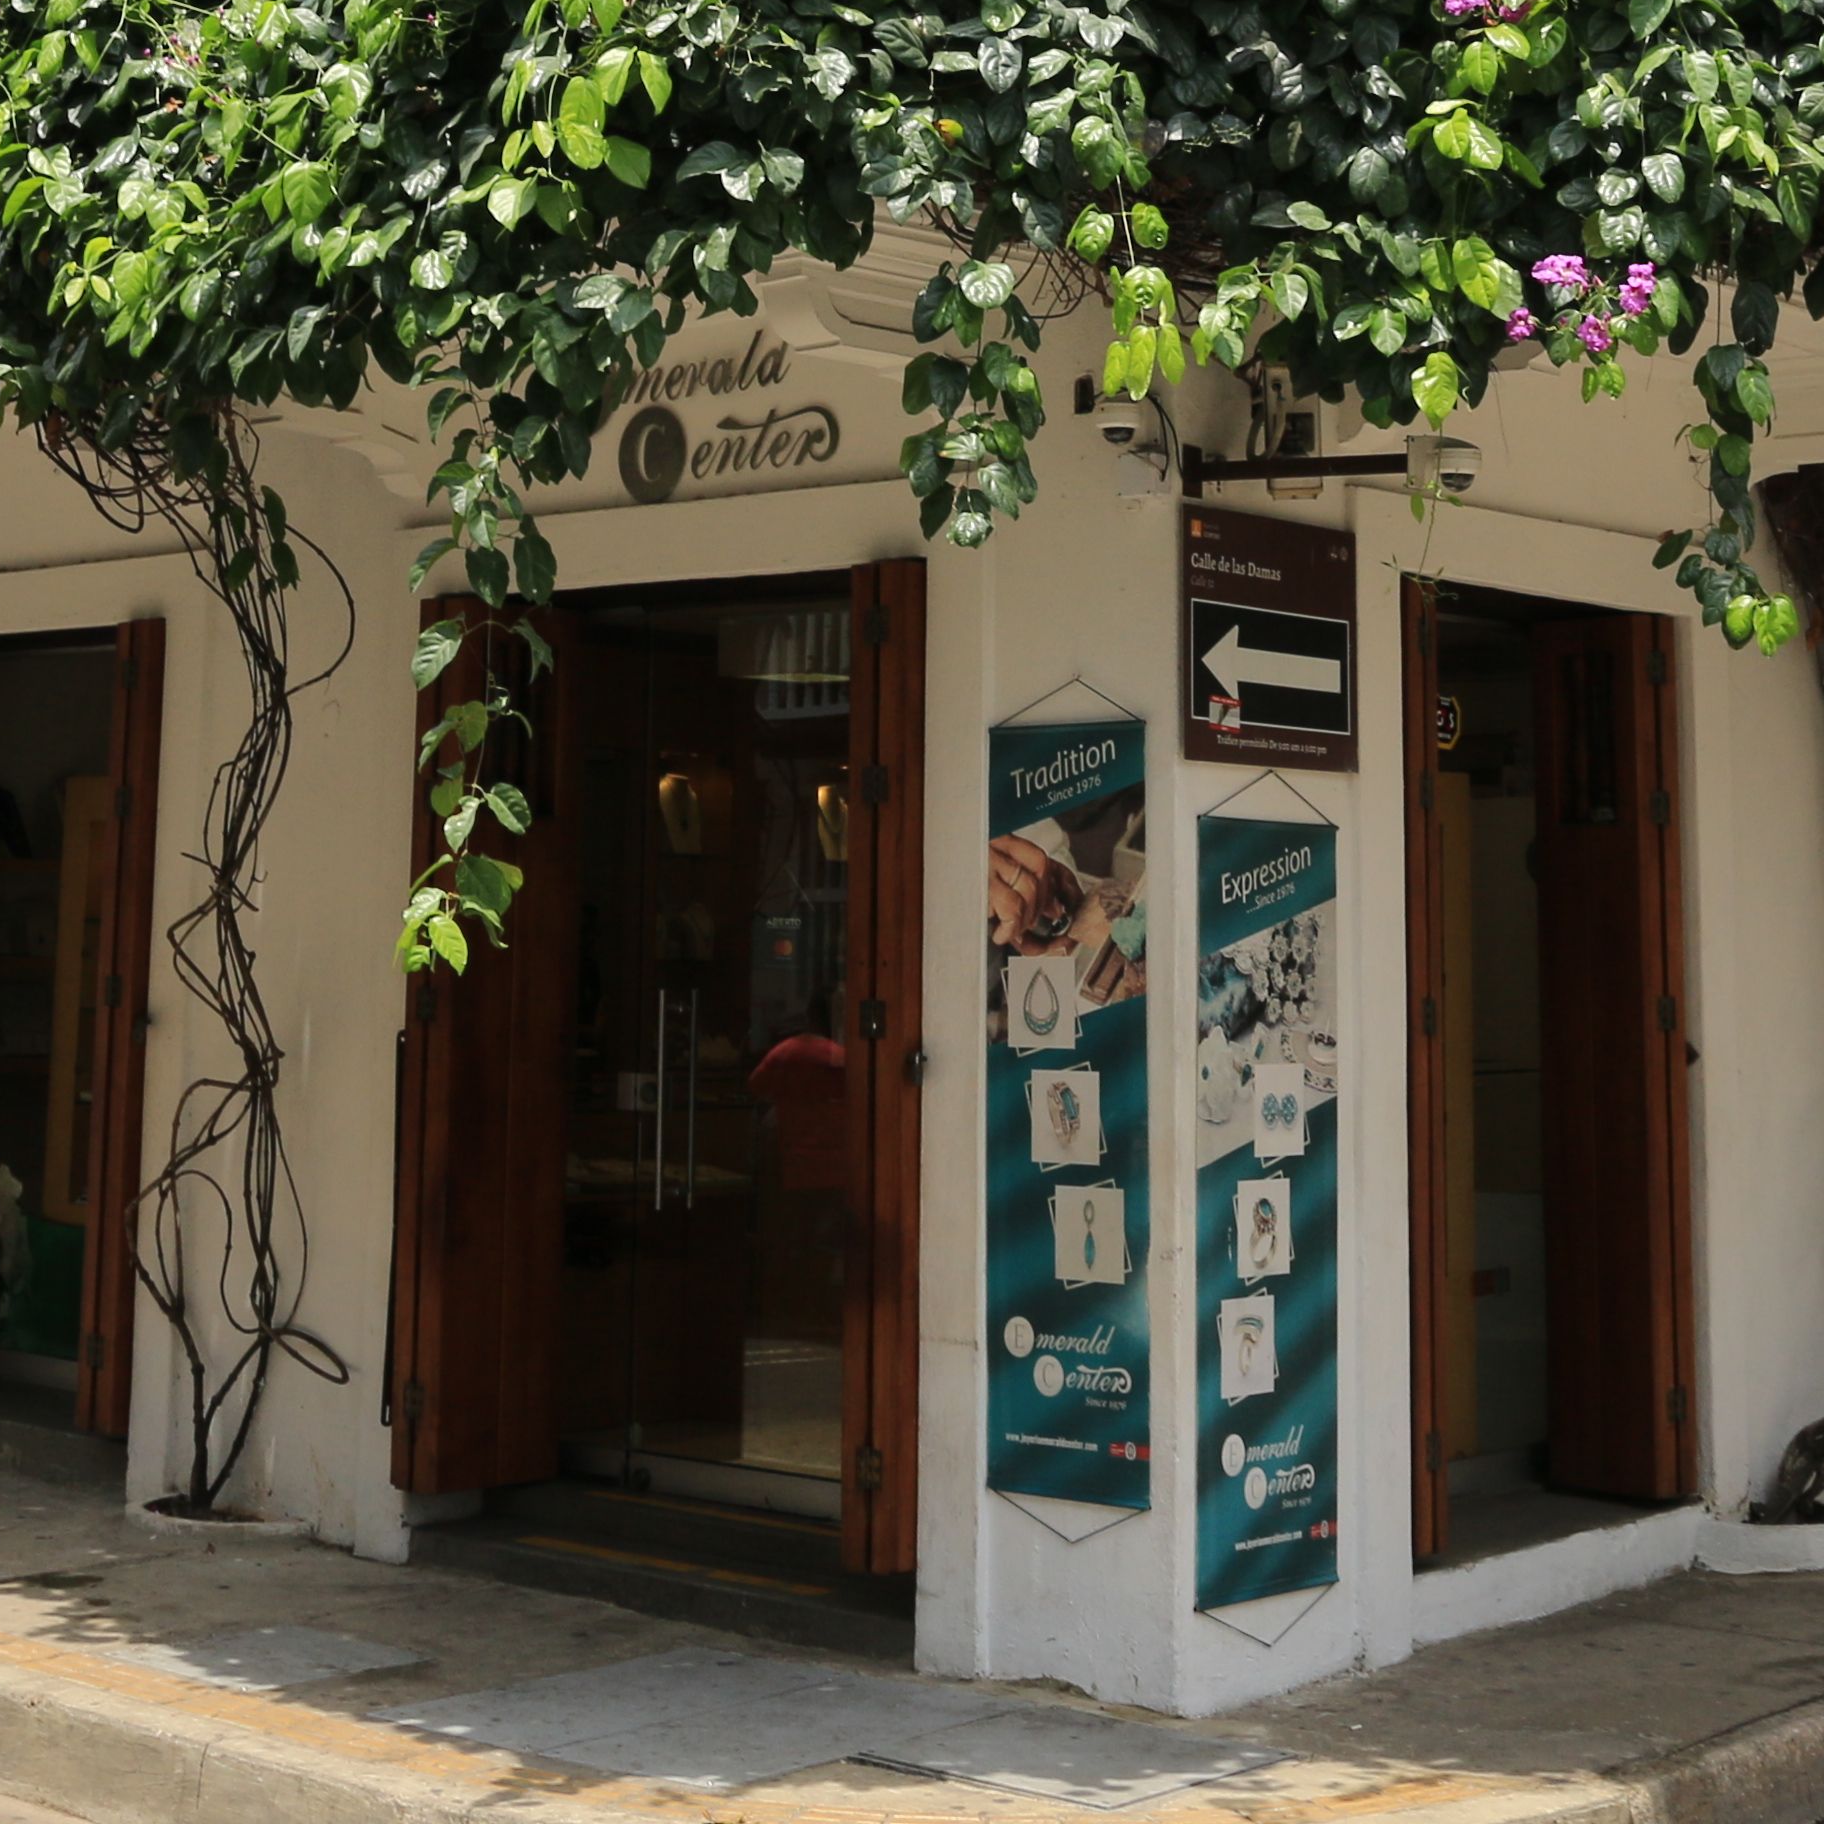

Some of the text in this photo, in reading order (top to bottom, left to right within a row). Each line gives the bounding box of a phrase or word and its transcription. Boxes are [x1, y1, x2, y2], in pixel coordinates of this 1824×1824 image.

[620, 330, 792, 404] merald
[619, 405, 840, 504] Center
[1191, 552, 1281, 581] Calle de las Damas
[1010, 739, 1116, 799] Tradition
[1076, 774, 1102, 795] 1976
[1221, 846, 1311, 904] Expression
[1276, 881, 1295, 901] 1976
[1004, 1316, 1116, 1358] Emerald
[1033, 1354, 1132, 1397] Center
[1085, 1396, 1107, 1408] Since
[1221, 1424, 1304, 1477] Emerald
[1244, 1463, 1315, 1510] Center
